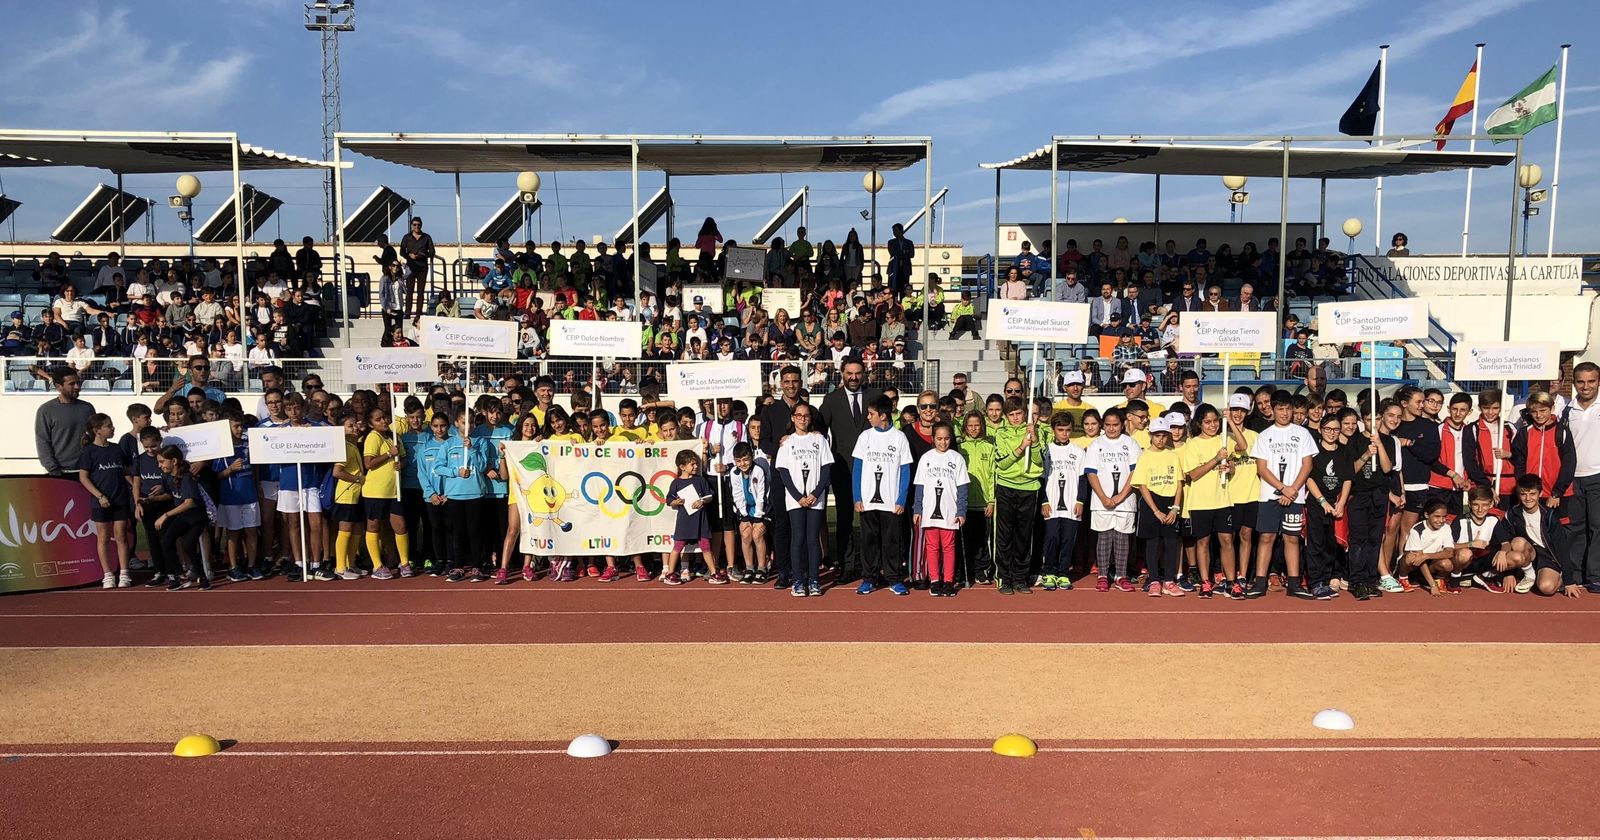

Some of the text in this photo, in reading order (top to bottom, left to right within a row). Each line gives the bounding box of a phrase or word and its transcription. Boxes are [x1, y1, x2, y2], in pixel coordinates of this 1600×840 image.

[1530, 265, 1579, 280] CARTUJA
[1007, 317, 1022, 325] CEIP
[1360, 324, 1381, 332] Savio
[445, 333, 494, 343] CEIP Concordia
[599, 335, 625, 343] Nombre
[1476, 356, 1502, 364] Colegio
[358, 362, 422, 371] CEIP CerroCoronado
[708, 377, 746, 385] Manantiales
[293, 441, 327, 449] Almendral
[541, 445, 572, 457] CIP
[618, 447, 668, 459] NOBRE
